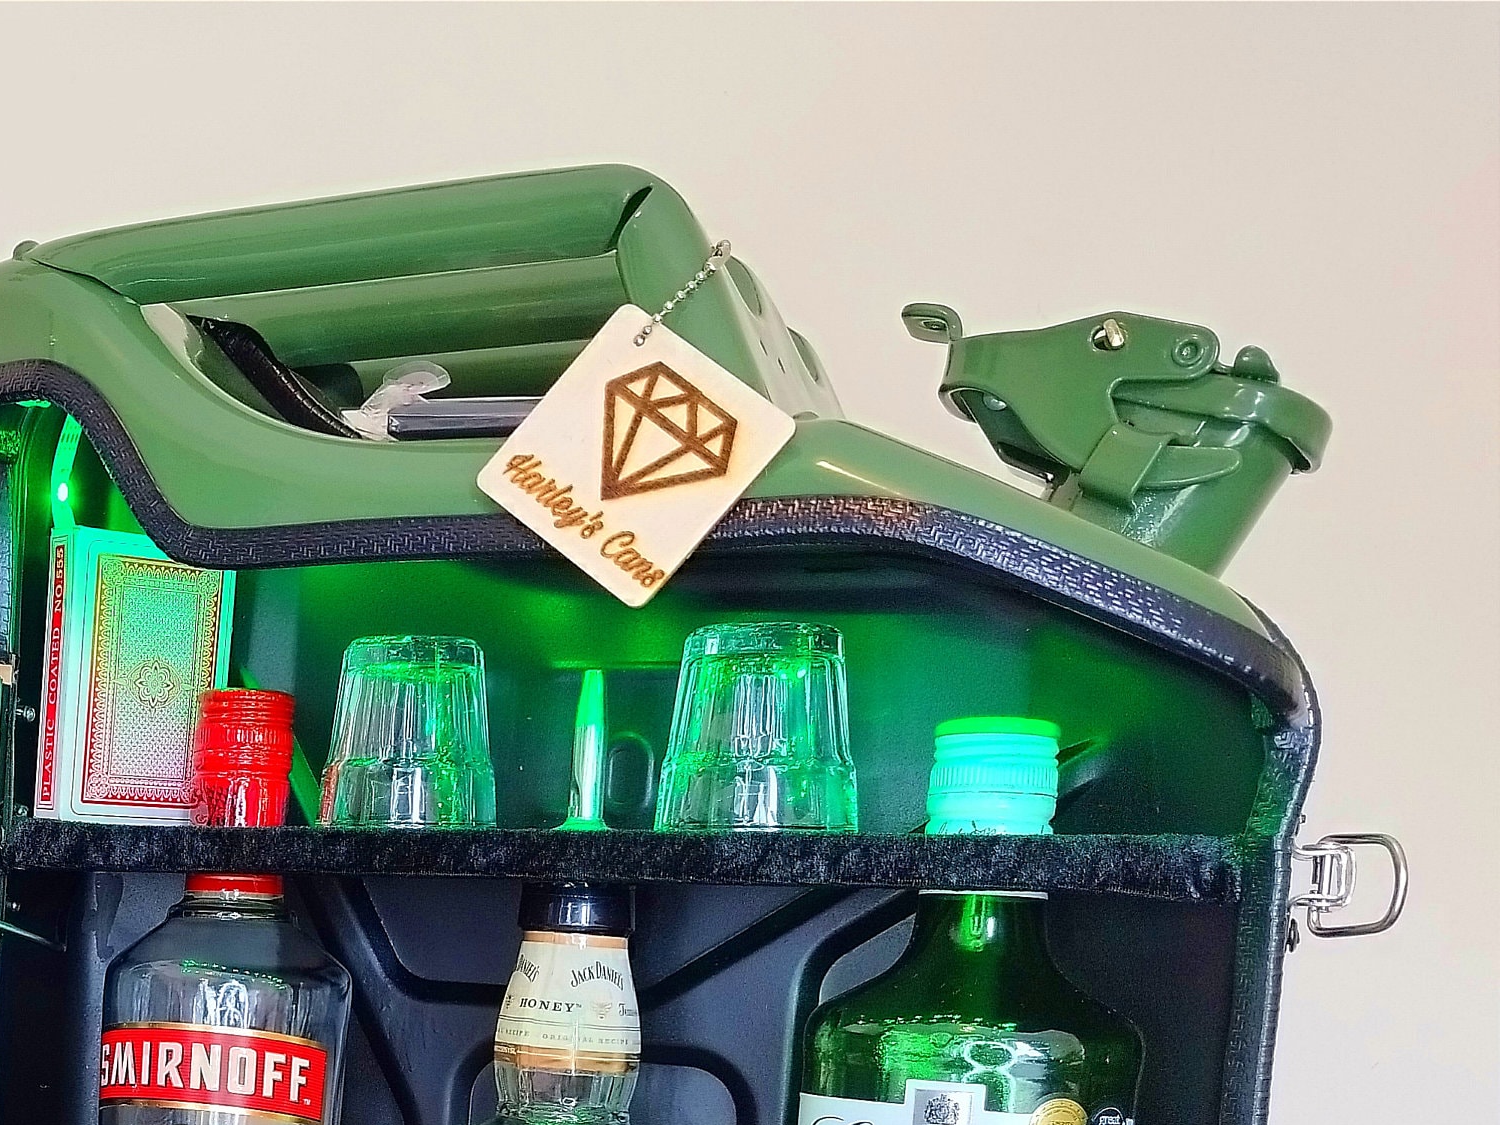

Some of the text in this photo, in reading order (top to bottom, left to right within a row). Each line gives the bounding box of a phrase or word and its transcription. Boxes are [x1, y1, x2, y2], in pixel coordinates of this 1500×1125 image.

[502, 454, 666, 588] Harley's Cans
[41, 718, 54, 798] PLASTIC
[48, 626, 60, 706] COATED
[519, 997, 575, 1013] HONEY
[570, 965, 595, 988] JACK
[100, 1041, 311, 1103] SMIRNOFF
